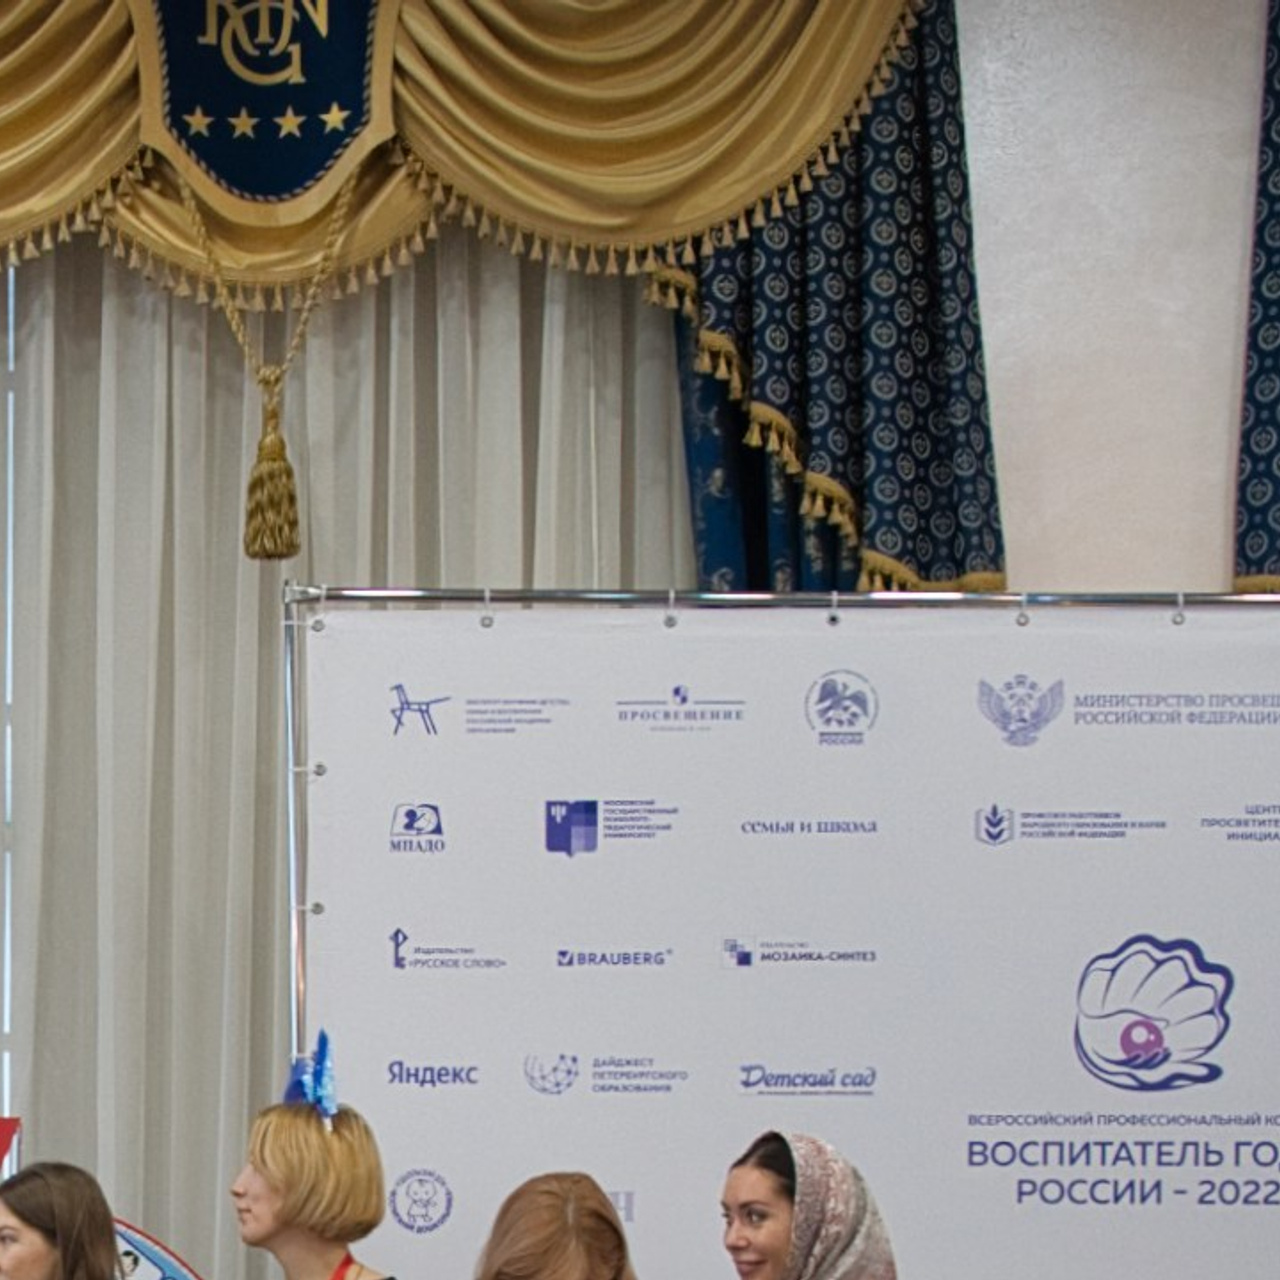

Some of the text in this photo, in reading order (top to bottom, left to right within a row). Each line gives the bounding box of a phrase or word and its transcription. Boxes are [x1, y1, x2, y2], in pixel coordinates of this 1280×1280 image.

[1074, 694, 1204, 708] МИНИСТЕРСТВО
[617, 710, 744, 721] ПРОСВЕЩЕНИЕ
[1074, 709, 1181, 725] РОССИЙСКОЙ
[1245, 804, 1280, 815] ЦЕНТ
[800, 821, 812, 833] И
[817, 821, 877, 833] ШКОЛА
[389, 839, 446, 853] МПАДО
[760, 951, 877, 961] МОЗАИКА-СИНТЕЗ
[387, 1060, 479, 1088] Яндекс
[740, 1064, 877, 1088] Детский сад
[967, 1112, 1093, 1127] ВСЕРОССИЙСКИЙ
[1097, 1112, 1262, 1127] ПРОФЕССИОНАЛЬНЫЙ
[967, 1140, 1280, 1171] ВОСПИТАТЕЛЬ ГО
[1016, 1179, 1163, 1205] РОССИИ
[1197, 1179, 1280, 1206] 2022
